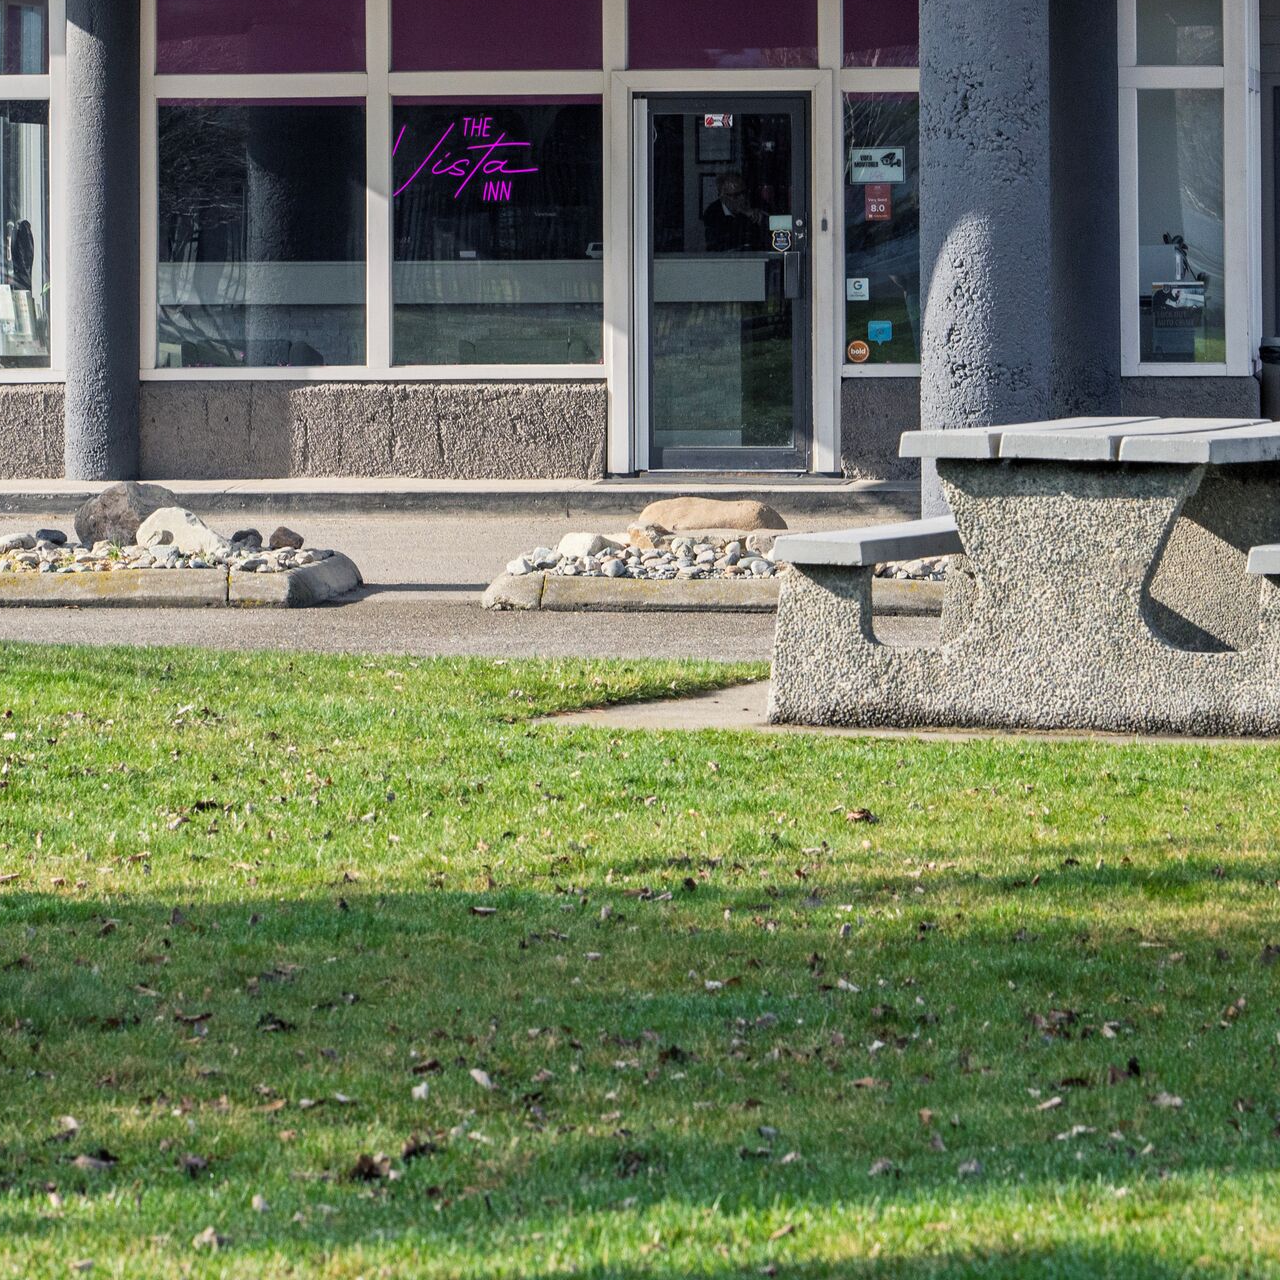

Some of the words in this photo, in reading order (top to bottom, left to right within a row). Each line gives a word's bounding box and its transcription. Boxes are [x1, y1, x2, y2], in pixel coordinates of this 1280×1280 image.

[463, 117, 494, 137] THE
[483, 181, 512, 201] INN
[870, 204, 885, 212] 8.0
